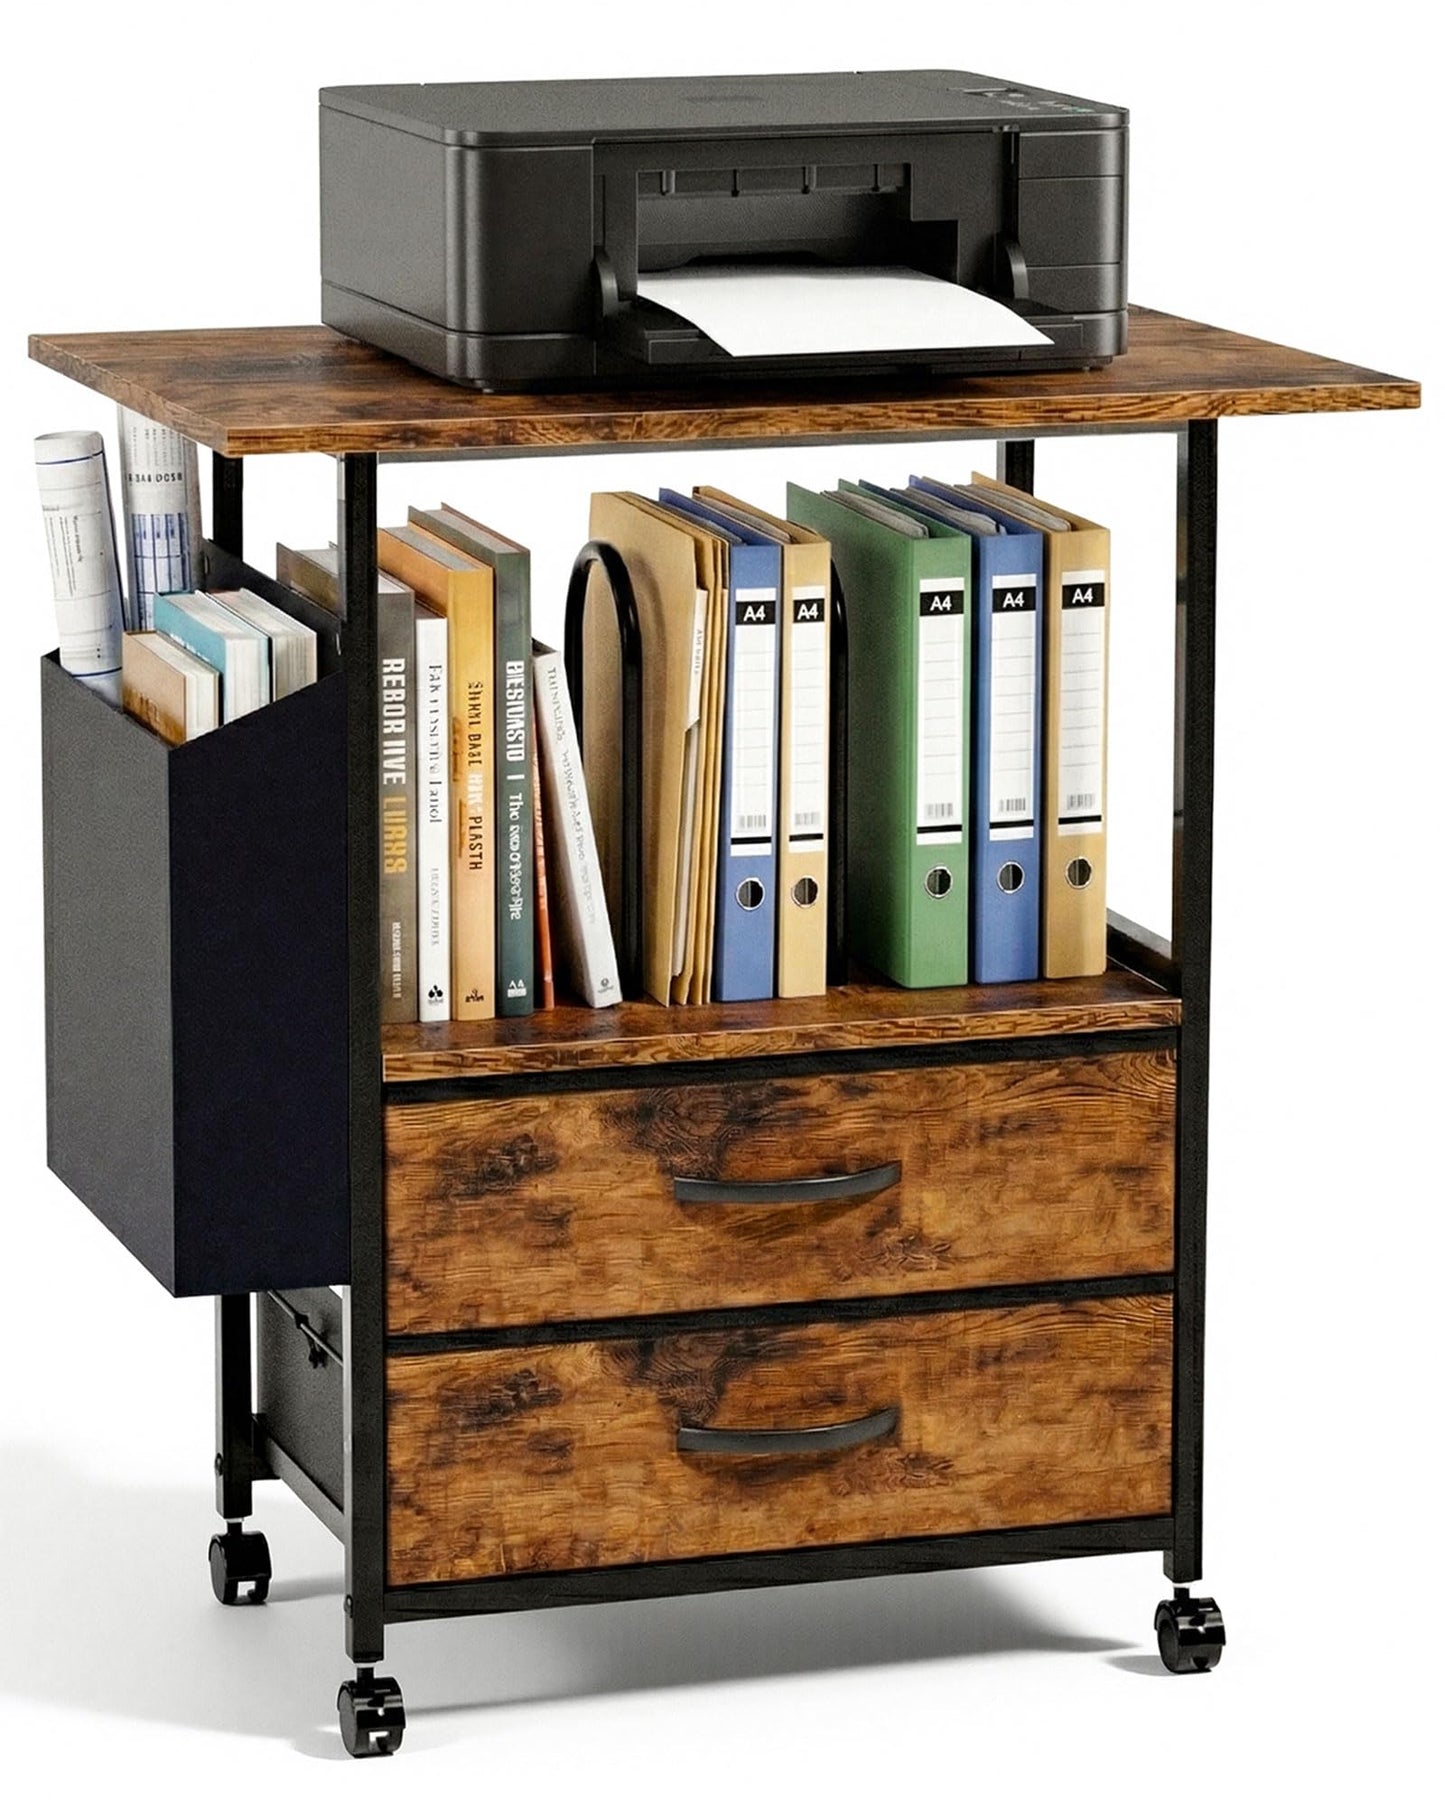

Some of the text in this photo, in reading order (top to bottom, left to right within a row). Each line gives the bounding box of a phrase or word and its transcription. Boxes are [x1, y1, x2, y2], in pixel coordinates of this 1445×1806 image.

[929, 594, 952, 612] A4
[1002, 591, 1025, 608] A4
[1071, 586, 1094, 604] A4
[743, 604, 766, 622] A4
[797, 602, 819, 620] A4
[382, 657, 406, 734] REBOR
